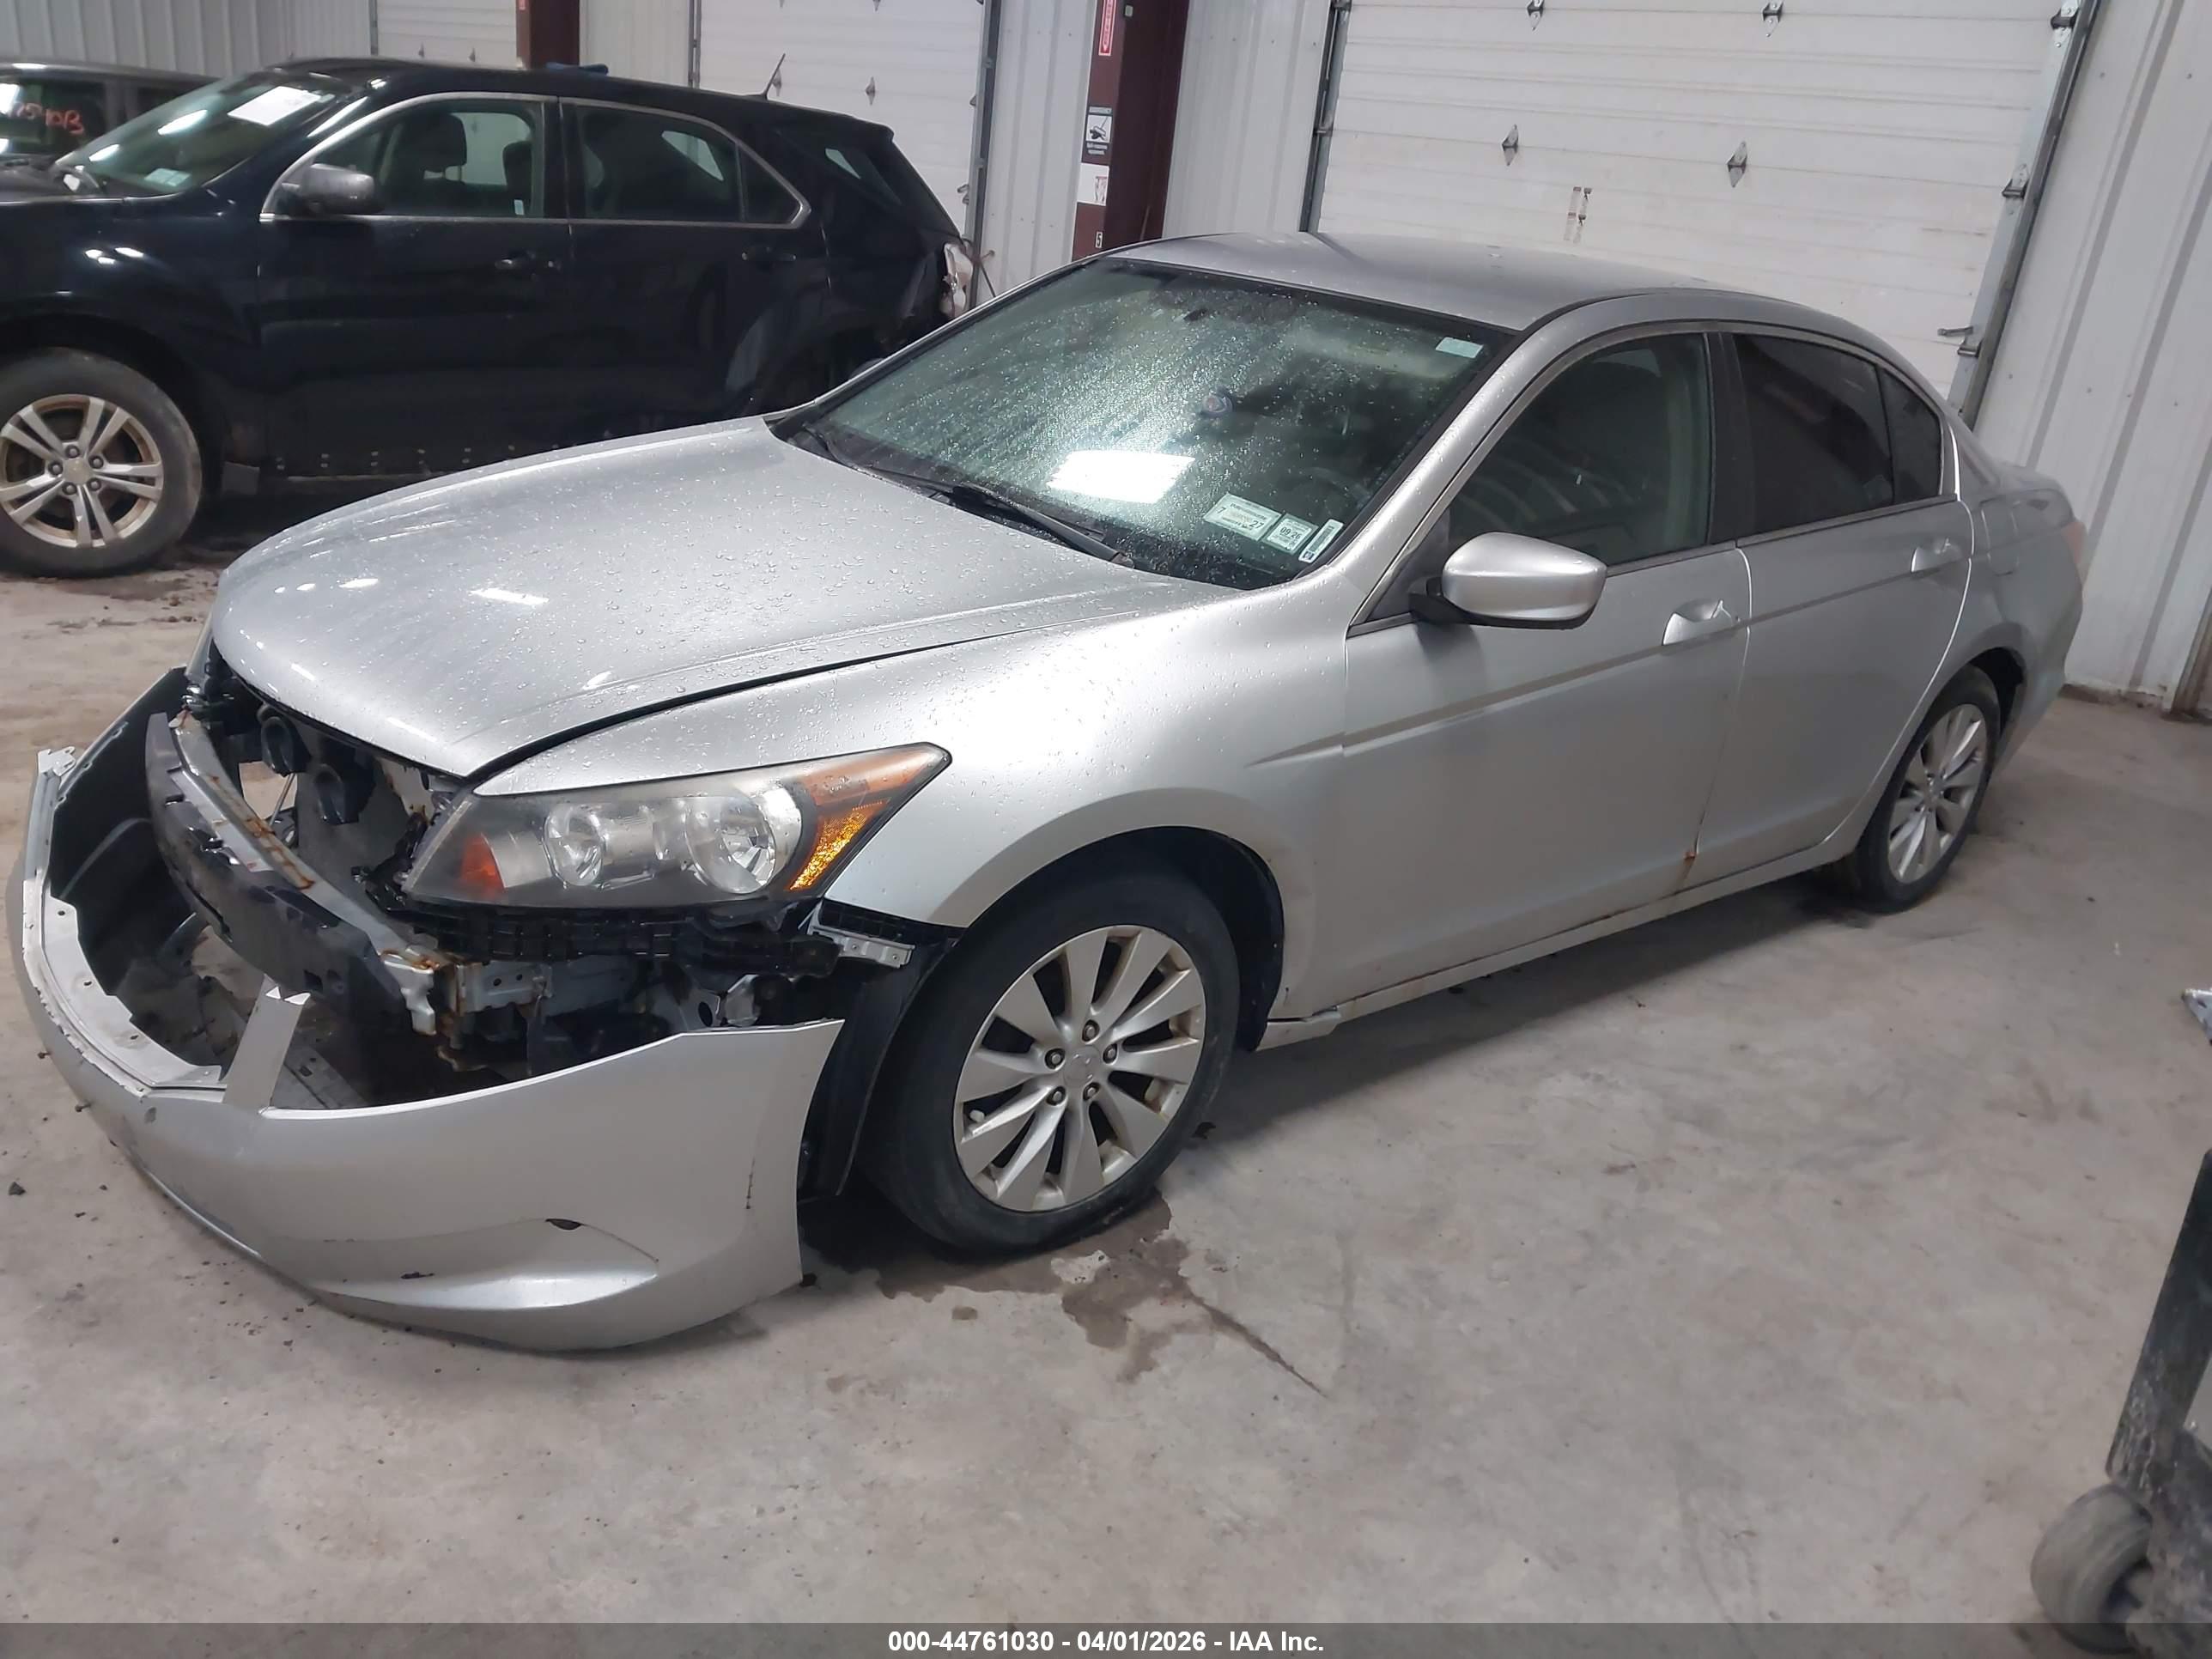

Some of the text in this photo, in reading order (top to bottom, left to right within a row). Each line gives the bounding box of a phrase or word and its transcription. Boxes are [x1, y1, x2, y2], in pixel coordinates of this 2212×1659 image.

[1096, 233, 1102, 247] 5
[1250, 520, 1265, 529] 27
[1279, 526, 1291, 537] 09
